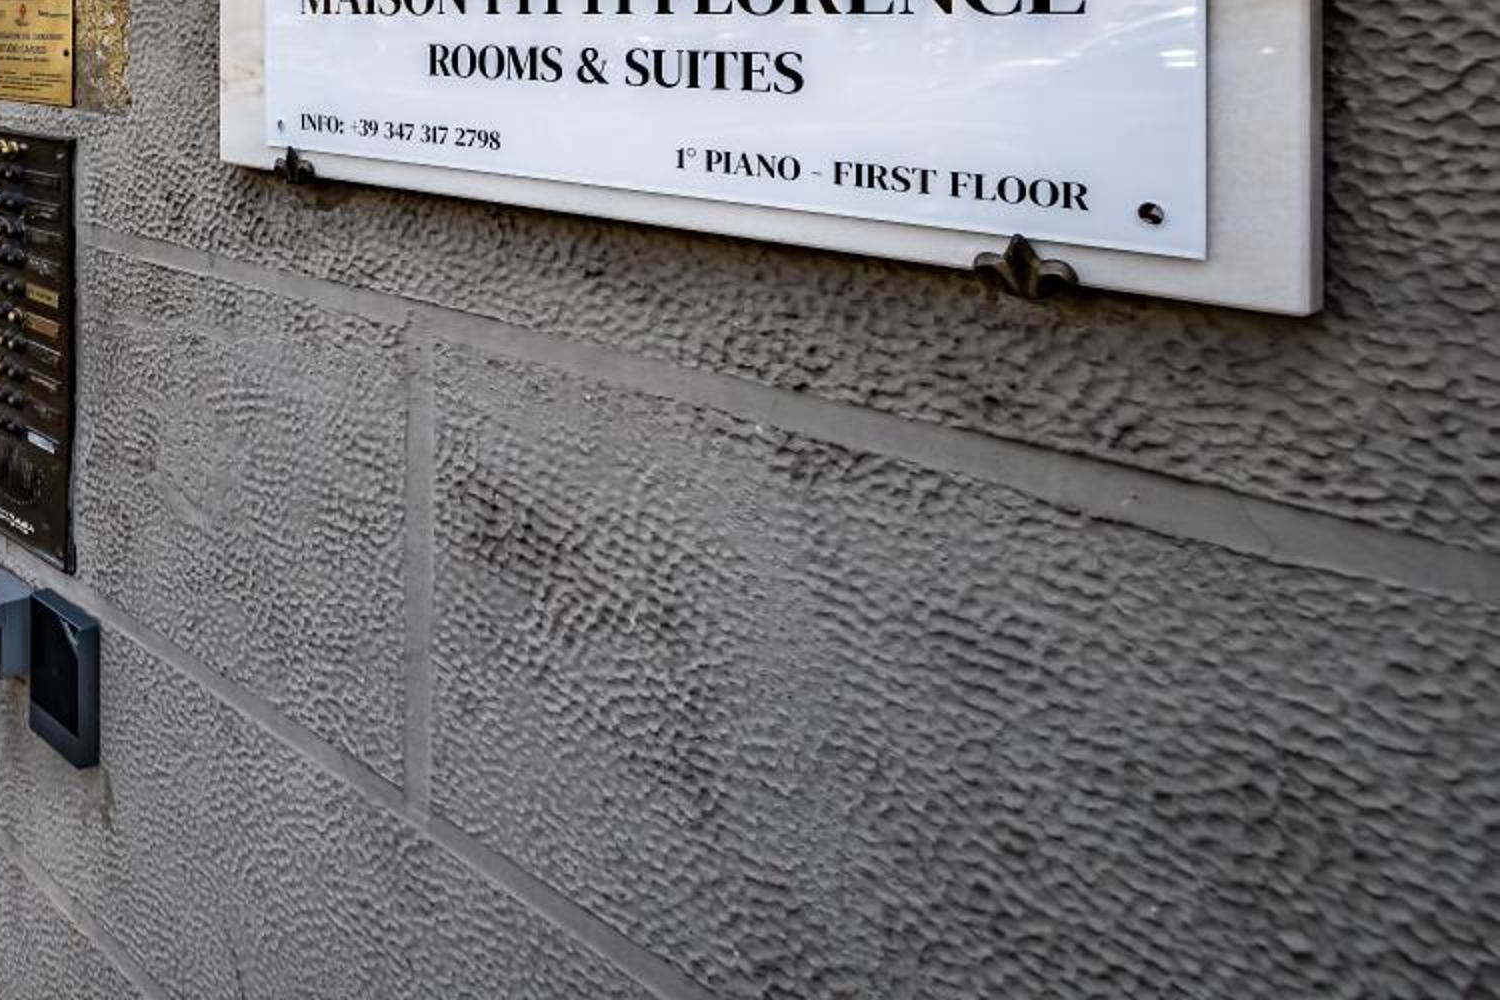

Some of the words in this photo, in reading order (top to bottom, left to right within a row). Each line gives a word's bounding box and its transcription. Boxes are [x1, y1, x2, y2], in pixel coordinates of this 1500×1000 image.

[428, 43, 563, 83] ROOMS
[576, 47, 610, 85] &
[625, 47, 805, 95] SUITES
[300, 113, 344, 135] INFO:
[350, 119, 379, 137] +39
[384, 121, 415, 141] 347
[420, 124, 449, 145] 317
[454, 127, 501, 151] 2798
[705, 150, 801, 182] PIANO
[833, 160, 937, 196] FIRST
[950, 171, 1090, 212] FLOOR
